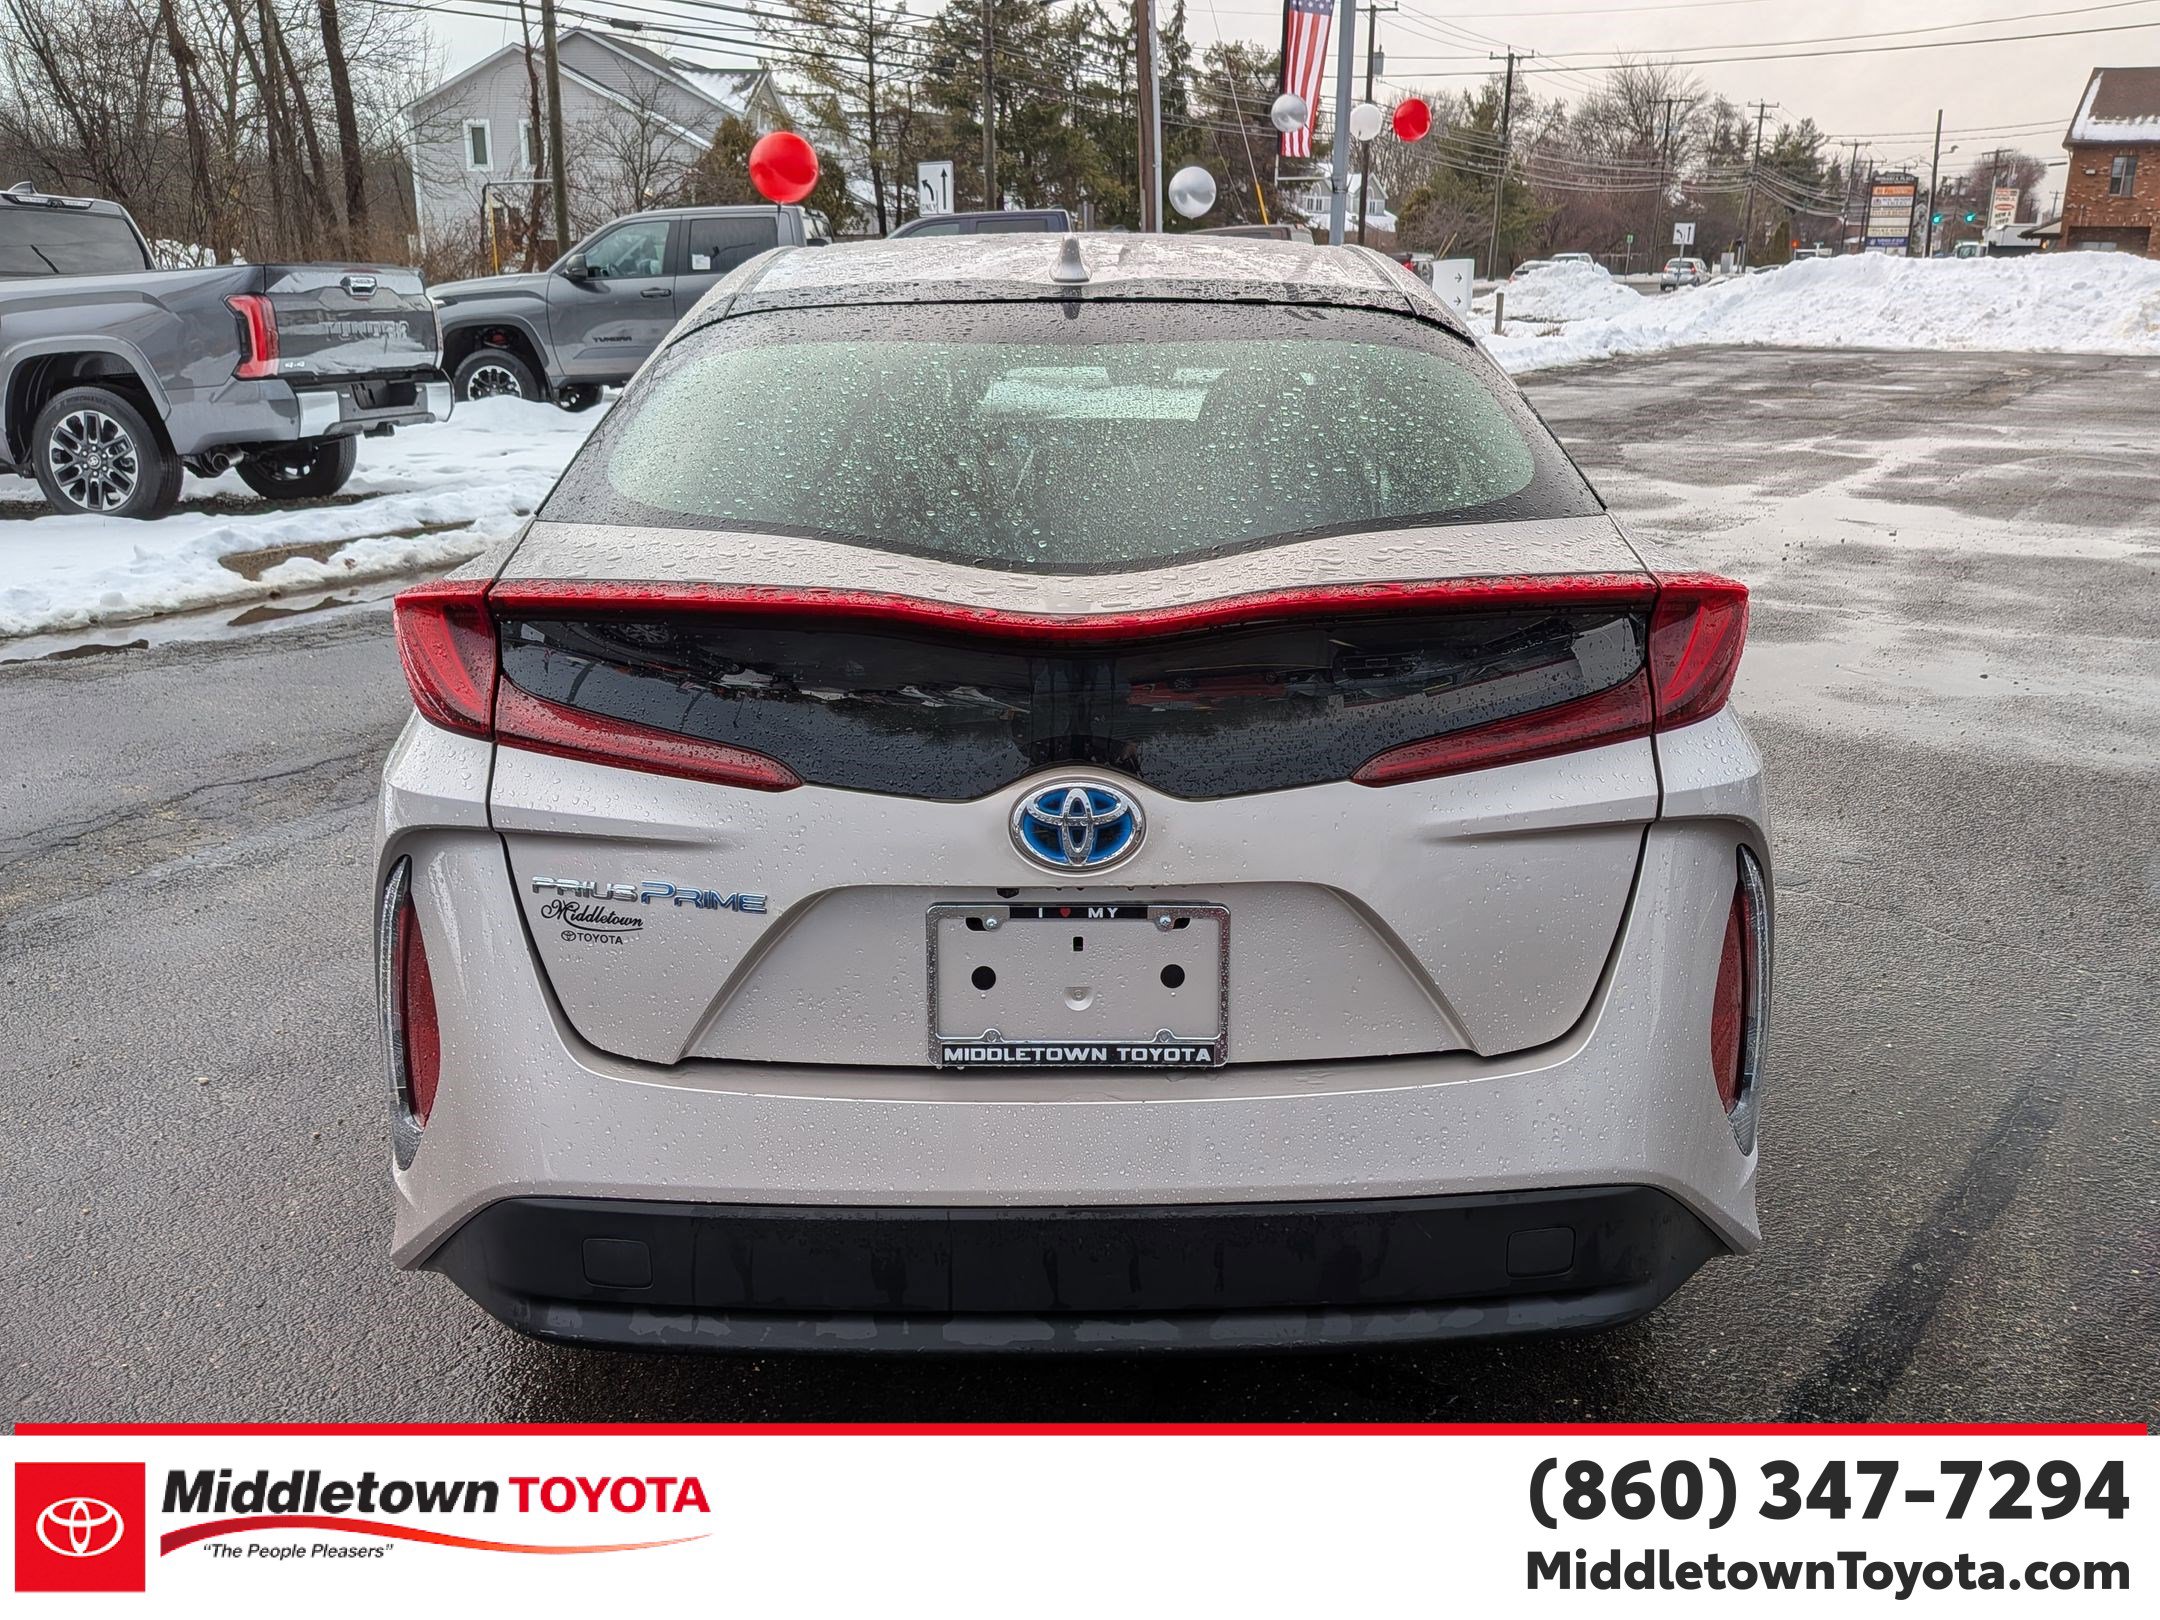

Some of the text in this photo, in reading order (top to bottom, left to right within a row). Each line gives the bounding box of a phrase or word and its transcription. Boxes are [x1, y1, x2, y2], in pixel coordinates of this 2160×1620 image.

[531, 875, 768, 915] PRIUS PRIME
[541, 899, 644, 932] Middletown
[1038, 907, 1118, 918] I MY
[576, 931, 623, 945] TOYOTA
[944, 1047, 1211, 1062] MIDDLETOWN TOYOTA
